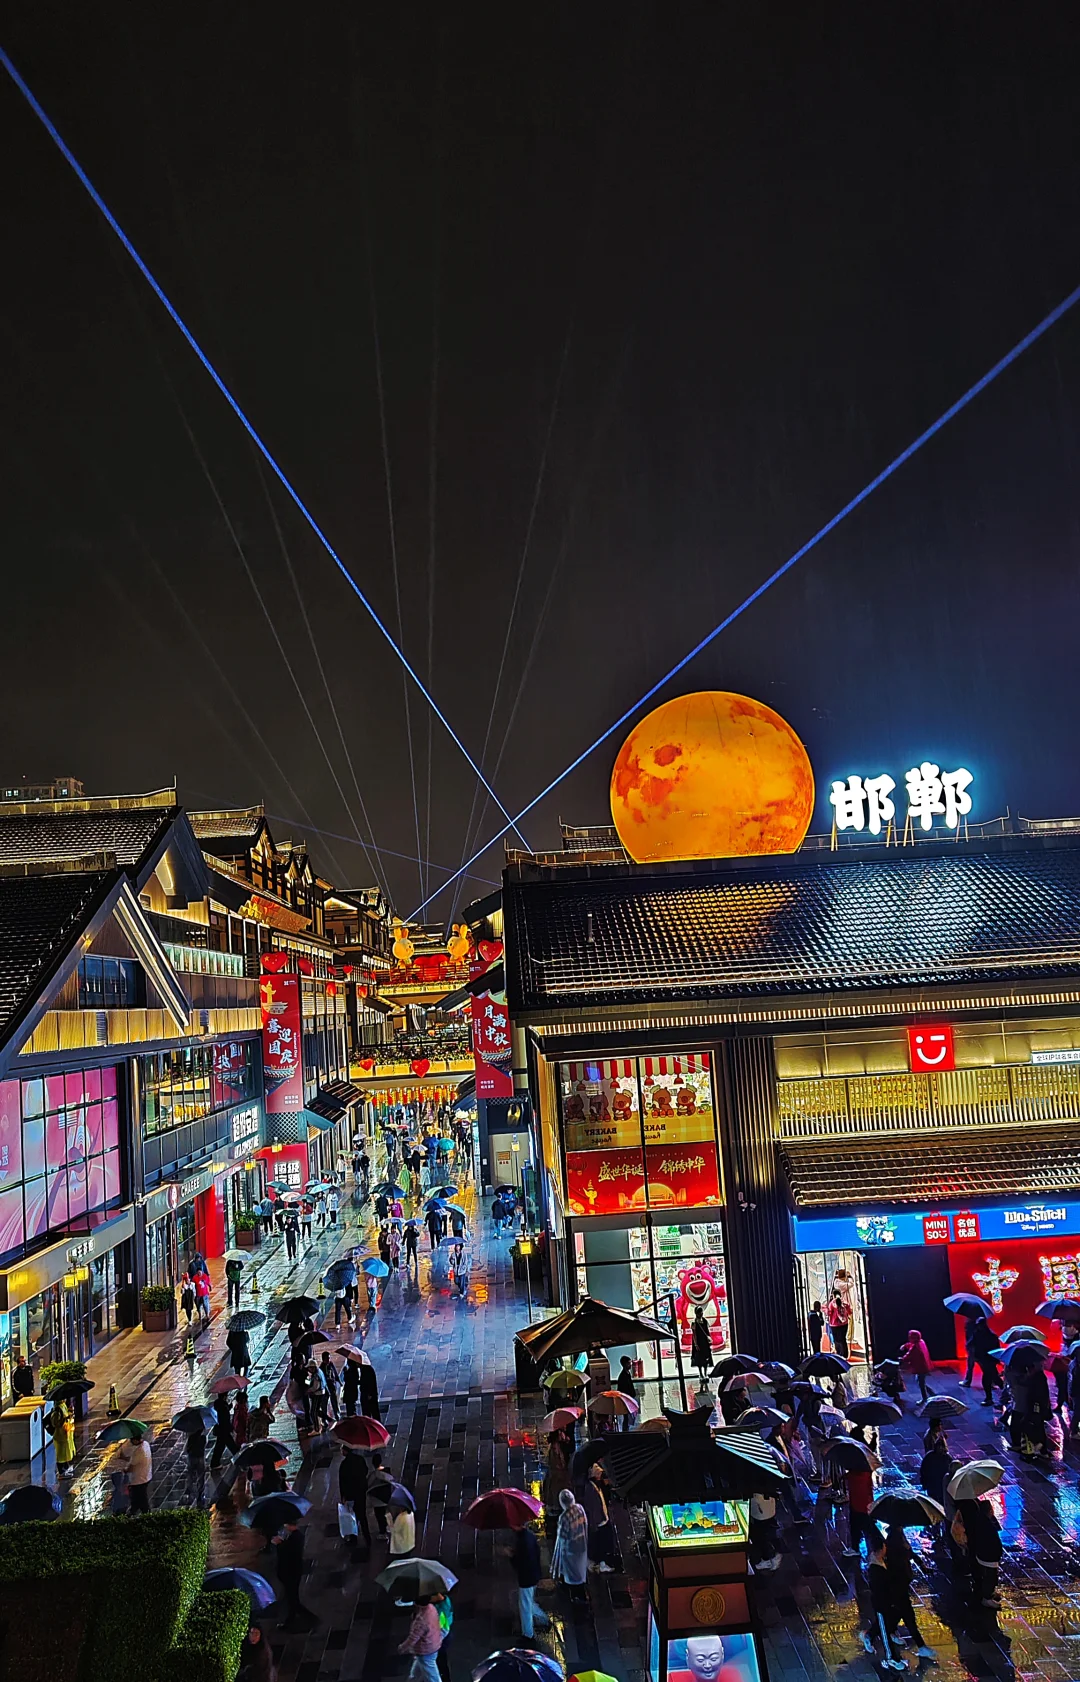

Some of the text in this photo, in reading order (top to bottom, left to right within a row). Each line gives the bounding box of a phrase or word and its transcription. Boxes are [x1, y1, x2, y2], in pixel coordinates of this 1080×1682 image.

[830, 761, 973, 835] 邯郸
[484, 1004, 510, 1046] 月满中秋
[267, 1018, 294, 1064] 喜迎国庆
[1036, 1052, 1080, 1062] 全球IP联名集合
[598, 1156, 706, 1182] 盛世华诞 锦绣中华
[181, 1176, 200, 1198] CHAGEE
[925, 1220, 947, 1230] MINI
[957, 1218, 976, 1228] 名创
[957, 1228, 977, 1238] 优品
